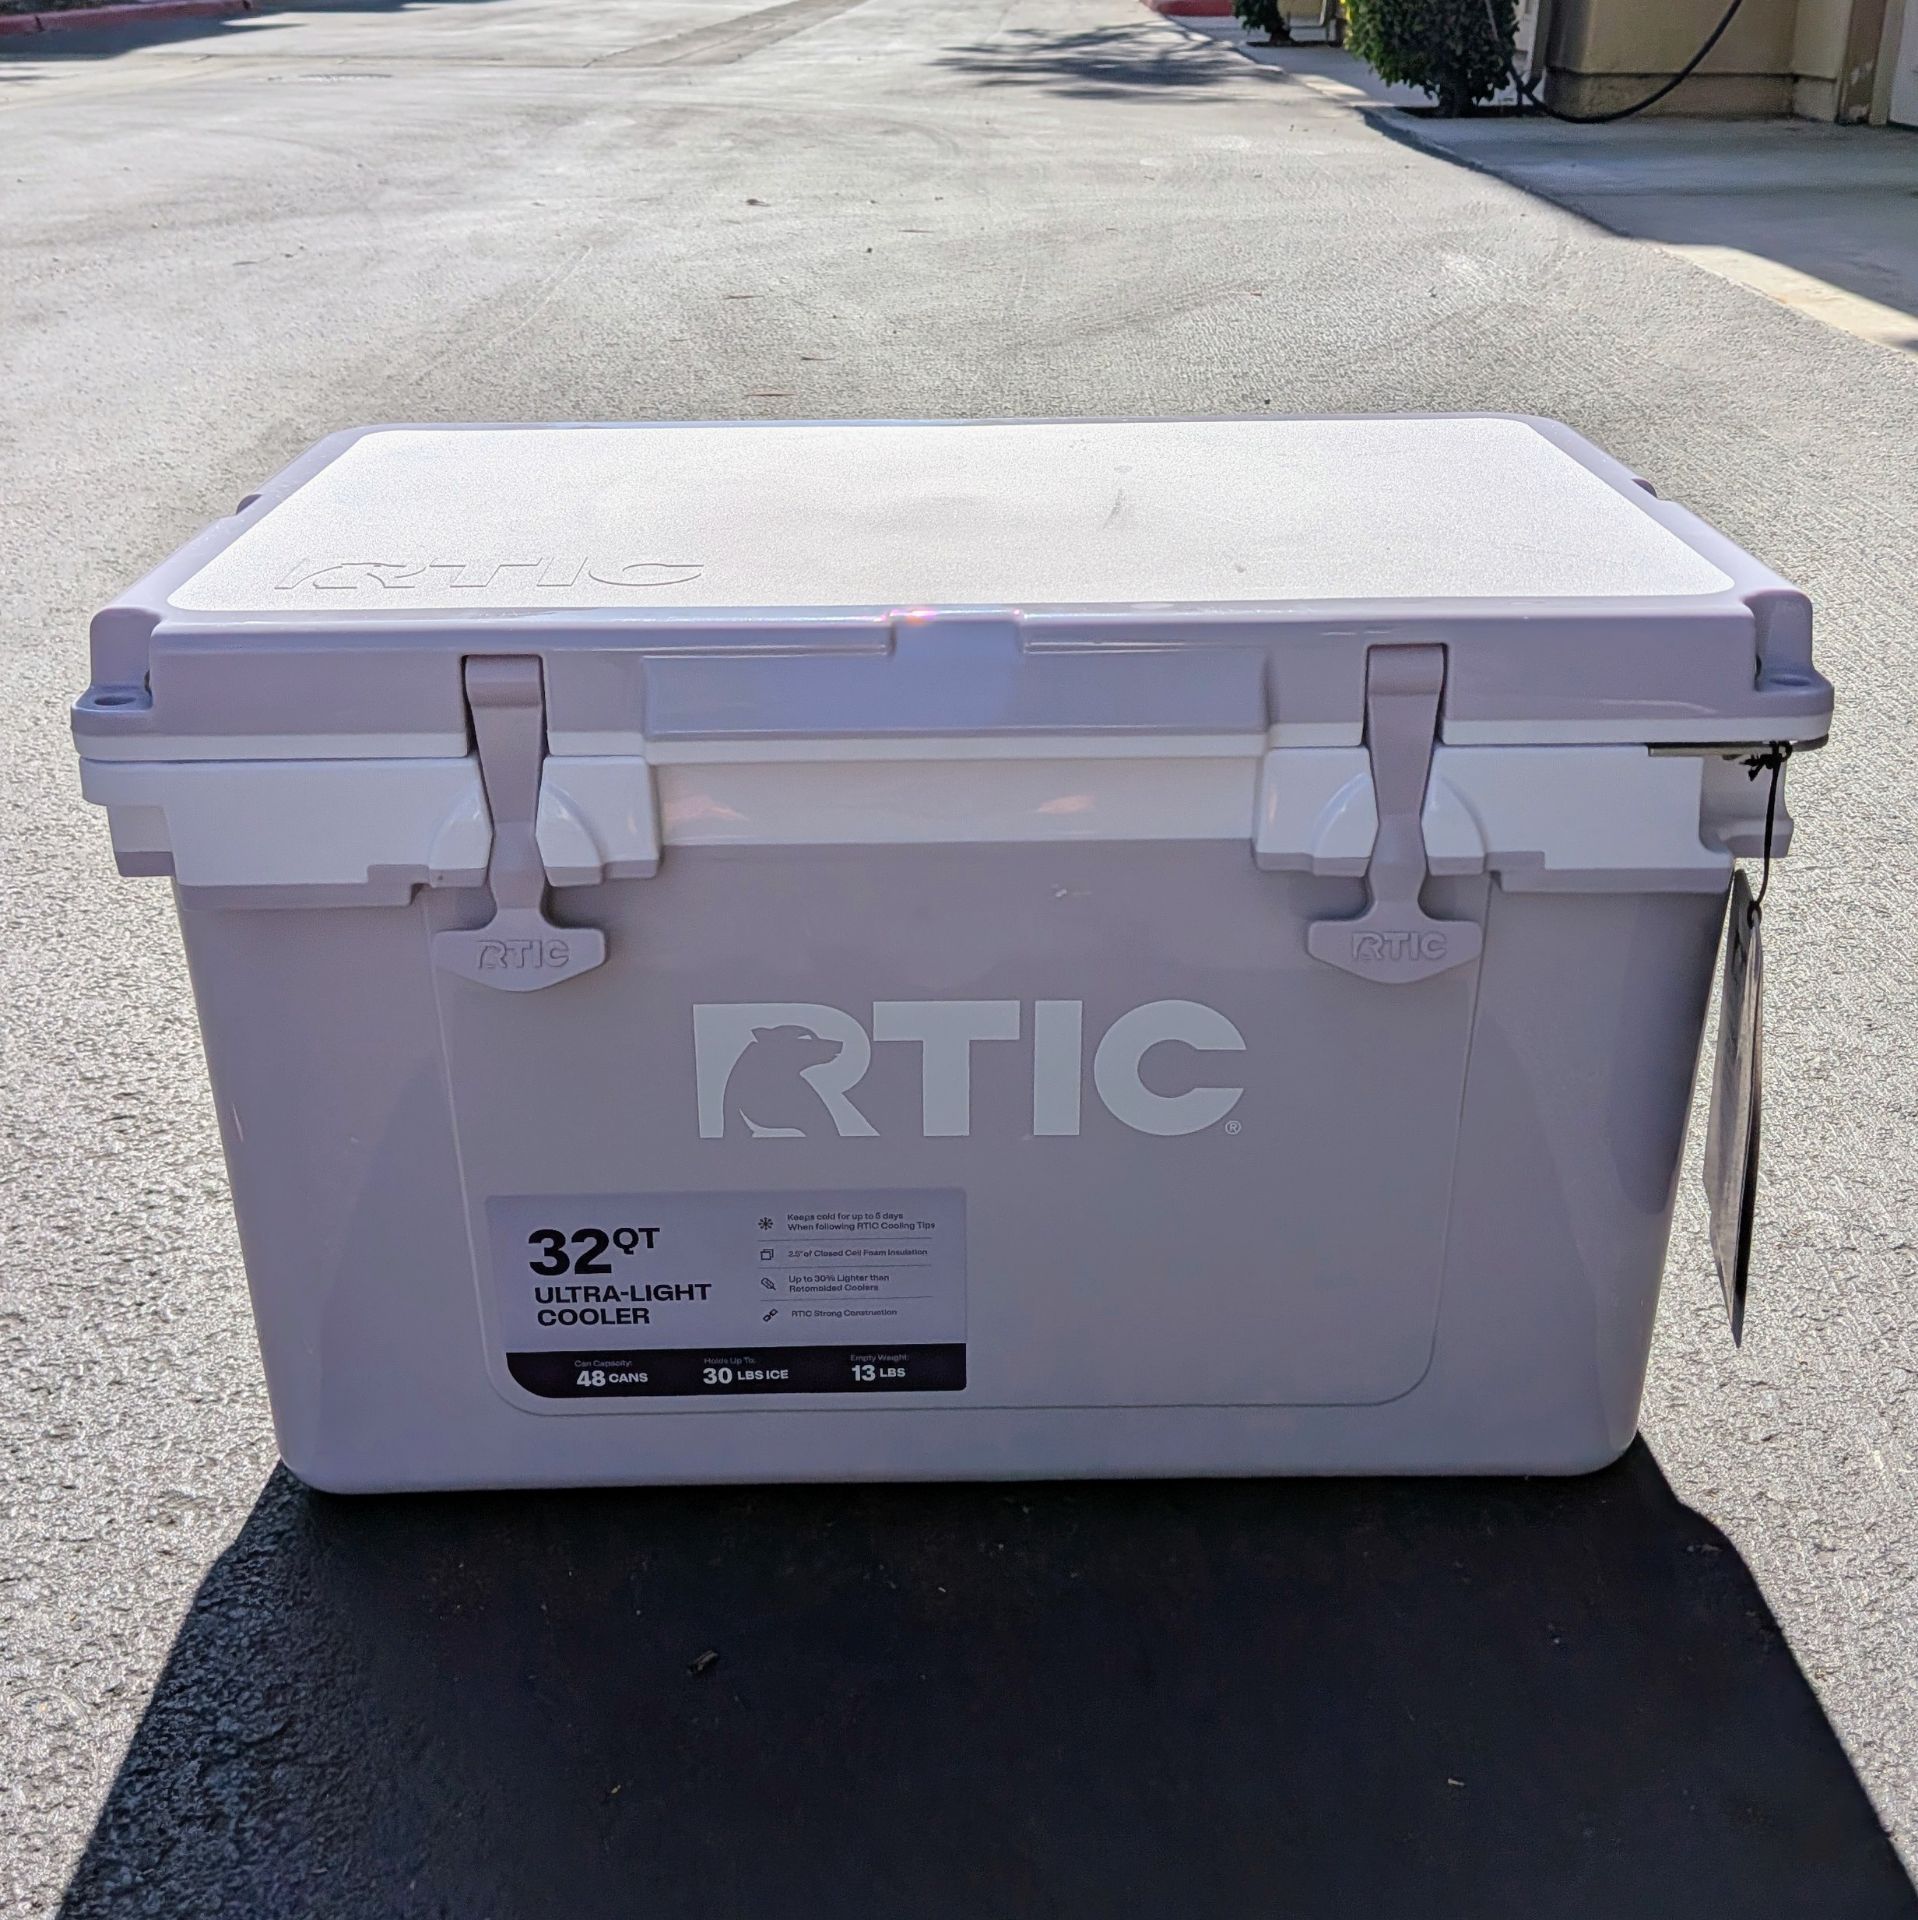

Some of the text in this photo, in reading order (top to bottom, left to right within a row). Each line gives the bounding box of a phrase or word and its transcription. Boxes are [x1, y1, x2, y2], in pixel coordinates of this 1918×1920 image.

[274, 557, 705, 590] RTIC
[476, 939, 570, 969] RTIC
[1351, 930, 1448, 961] RTIC
[692, 999, 1247, 1138] RTIC
[787, 1213, 815, 1221] Keeps
[816, 1212, 836, 1220] cold
[837, 1212, 851, 1220] for
[852, 1213, 863, 1221] up
[882, 1212, 904, 1221] days
[787, 1221, 936, 1232] When following RTIC Cooling Tips
[528, 1227, 661, 1276] 32 QT
[803, 1249, 812, 1257] of
[813, 1249, 844, 1257] Closed
[845, 1249, 862, 1257] Cell
[887, 1248, 928, 1256] Insulation
[788, 1275, 802, 1284] Up
[803, 1275, 812, 1283] to
[814, 1274, 836, 1283] 30%
[837, 1274, 868, 1283] Lighter
[534, 1283, 712, 1305] ULTRA-LIGHT
[789, 1283, 879, 1293] Rotomolded Coolers
[537, 1307, 651, 1327] COOLER
[791, 1309, 898, 1318] RTIC Strong Construction
[729, 1357, 743, 1365] Up
[850, 1355, 876, 1363] Empty
[576, 1370, 649, 1387] 48 CANS
[703, 1367, 789, 1385] 30 LBS ICE
[851, 1365, 906, 1382] 13 LBS
